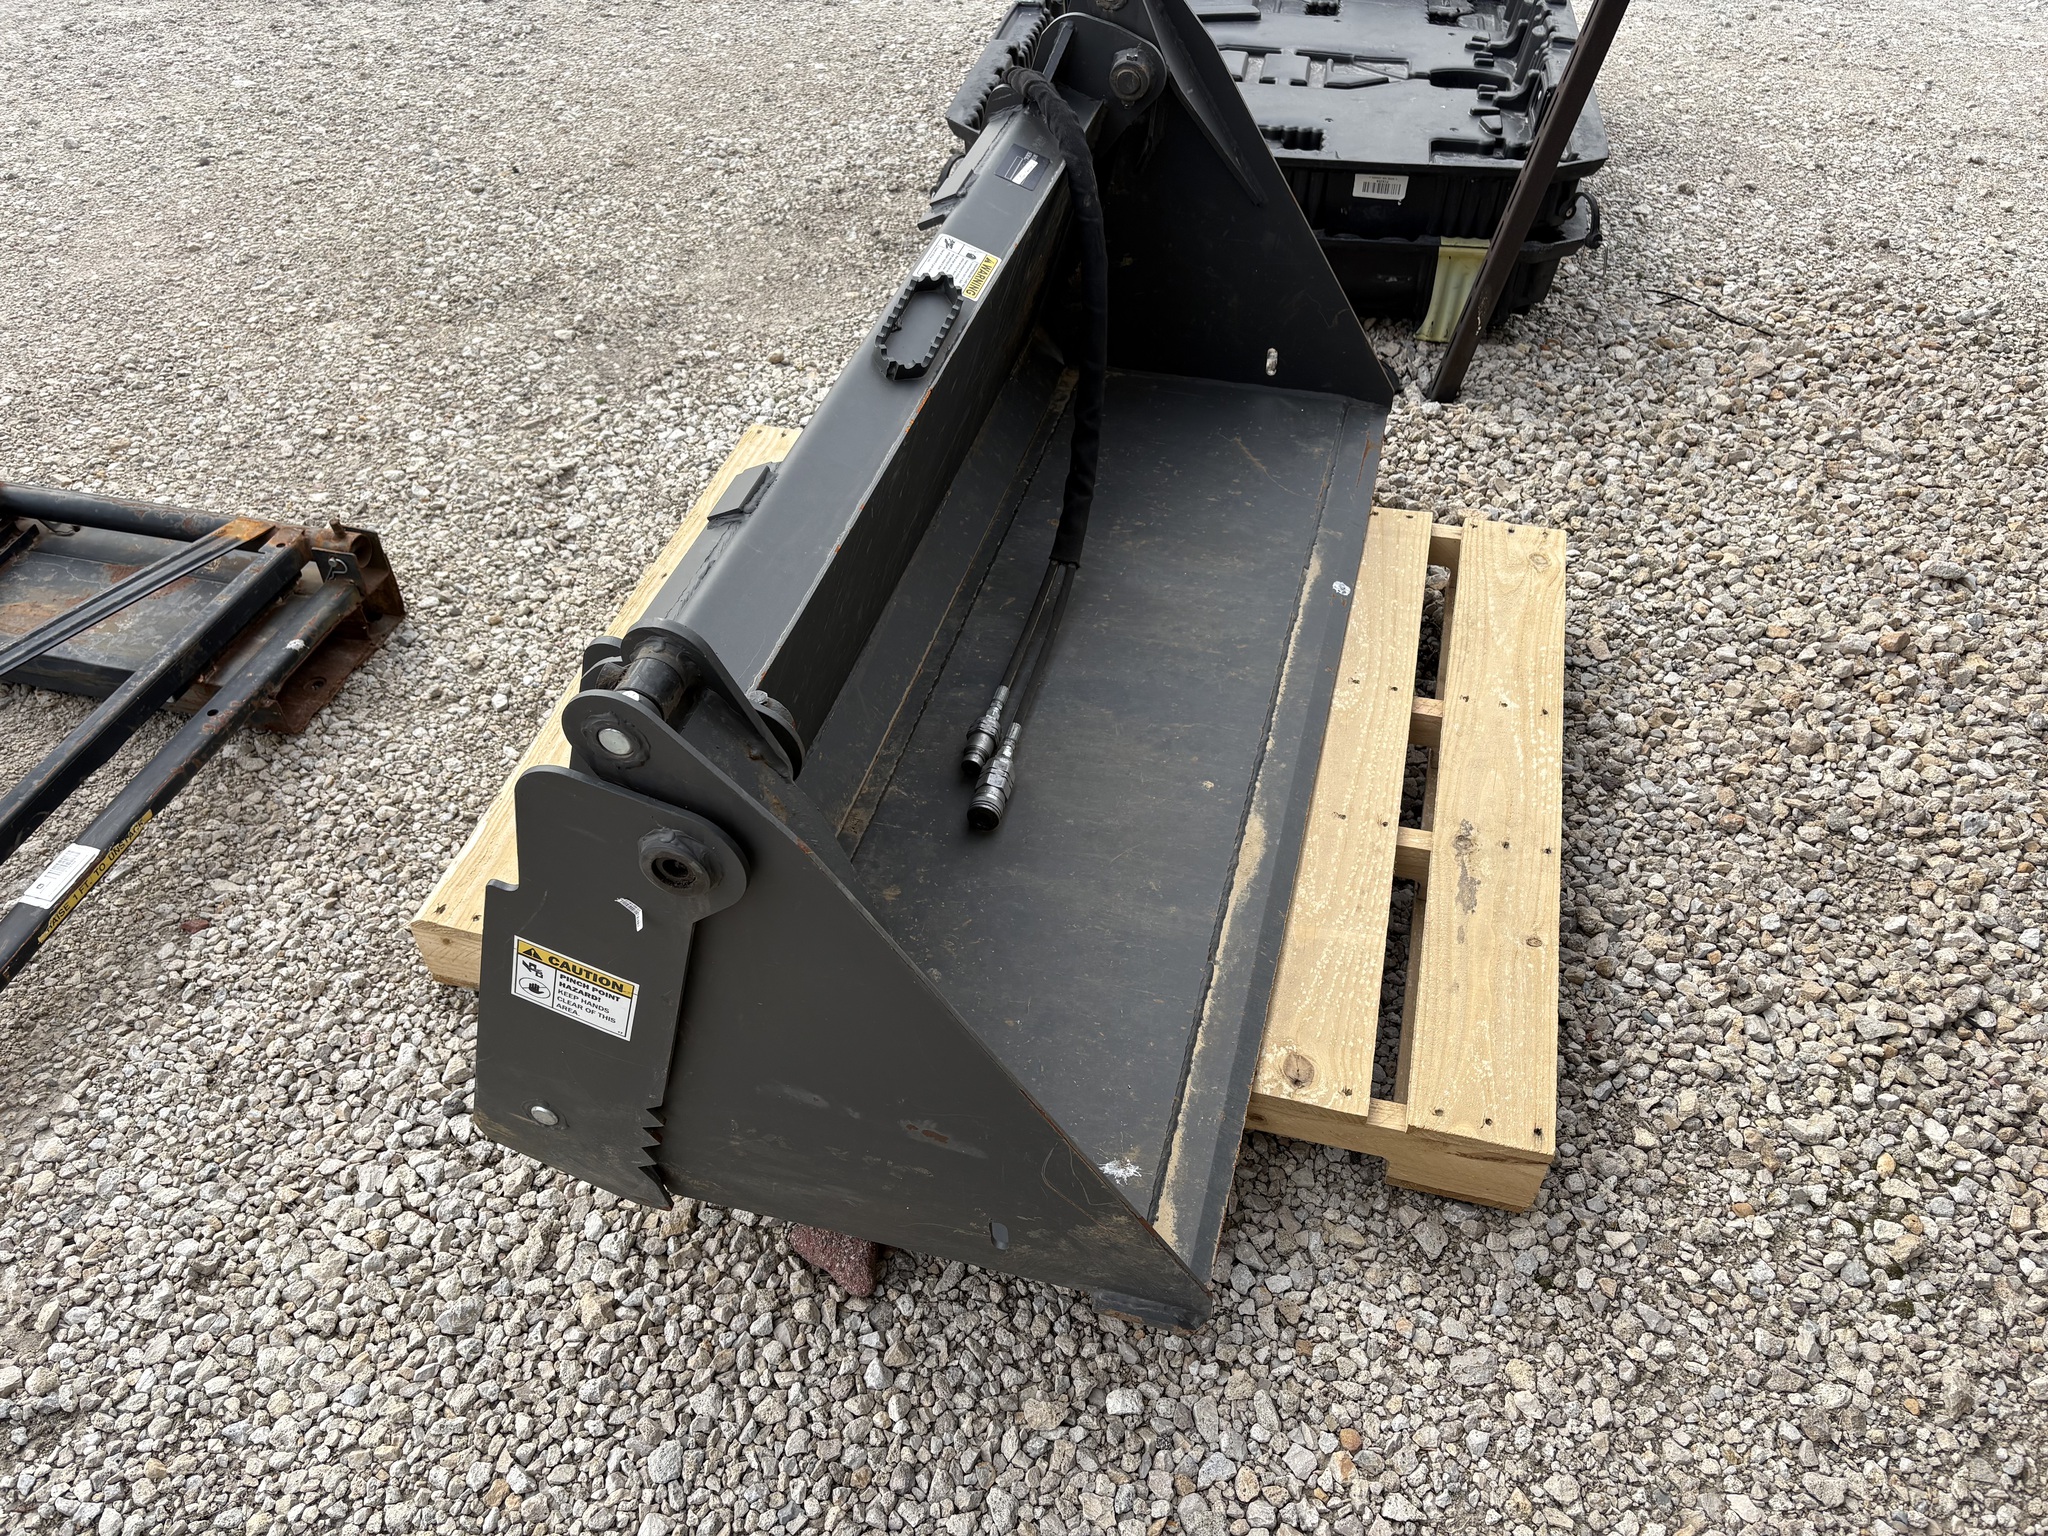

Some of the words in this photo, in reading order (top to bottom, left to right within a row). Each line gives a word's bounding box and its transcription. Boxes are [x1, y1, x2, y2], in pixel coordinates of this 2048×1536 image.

[966, 264, 992, 296] WARNING
[79, 880, 93, 895] FT.
[94, 863, 106, 877] TO
[548, 956, 624, 993] CAUTION
[560, 973, 590, 990] PINCH
[592, 986, 621, 1002] POINT
[558, 989, 579, 1000] KEEP
[581, 998, 610, 1014] HANDS
[559, 981, 602, 1003] HAZARD!
[556, 1003, 581, 1016] AREA.
[557, 996, 584, 1011] CLEAR
[585, 1007, 597, 1015] OF
[598, 1012, 616, 1024] THIS
